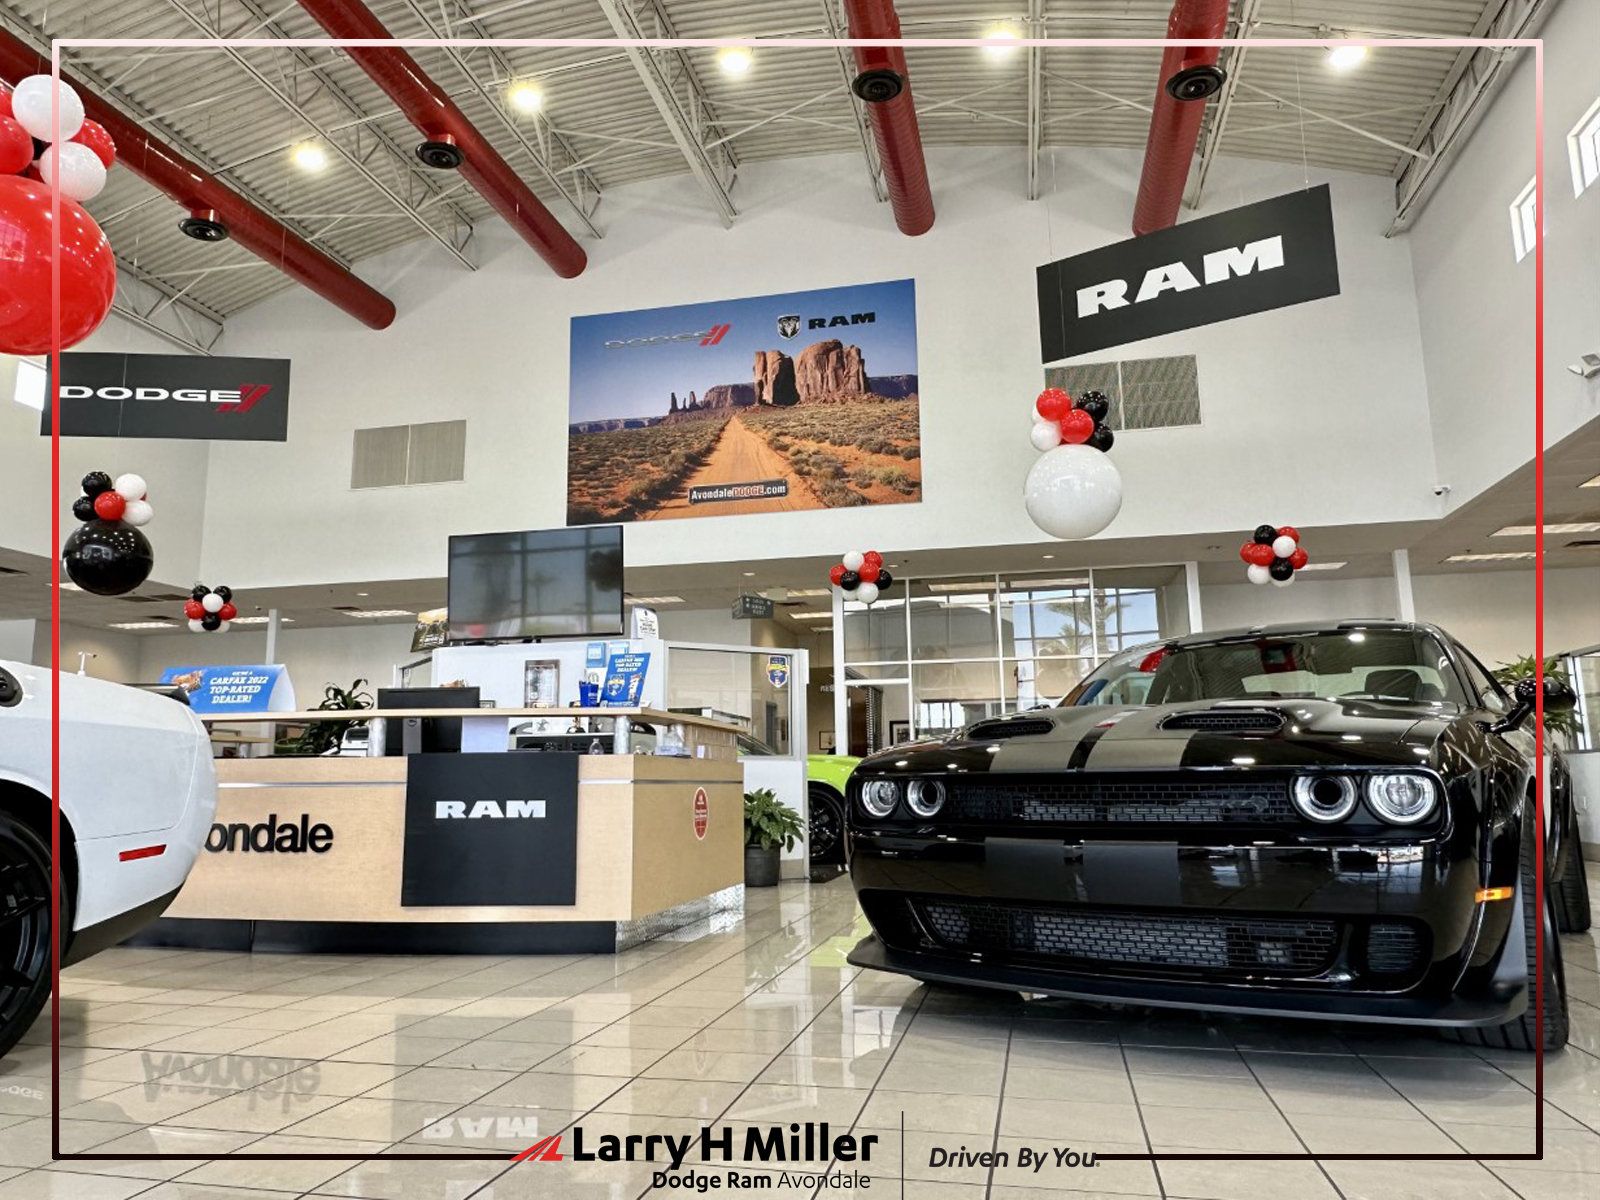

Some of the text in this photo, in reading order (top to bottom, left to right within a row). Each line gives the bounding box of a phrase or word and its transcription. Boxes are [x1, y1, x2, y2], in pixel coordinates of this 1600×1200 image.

[1076, 234, 1285, 319] RAM
[808, 311, 876, 330] RAM
[59, 385, 242, 403] DODGE
[691, 484, 786, 500] AvondaleDODGE.com
[435, 799, 546, 819] RAM
[204, 813, 334, 853] ondale
